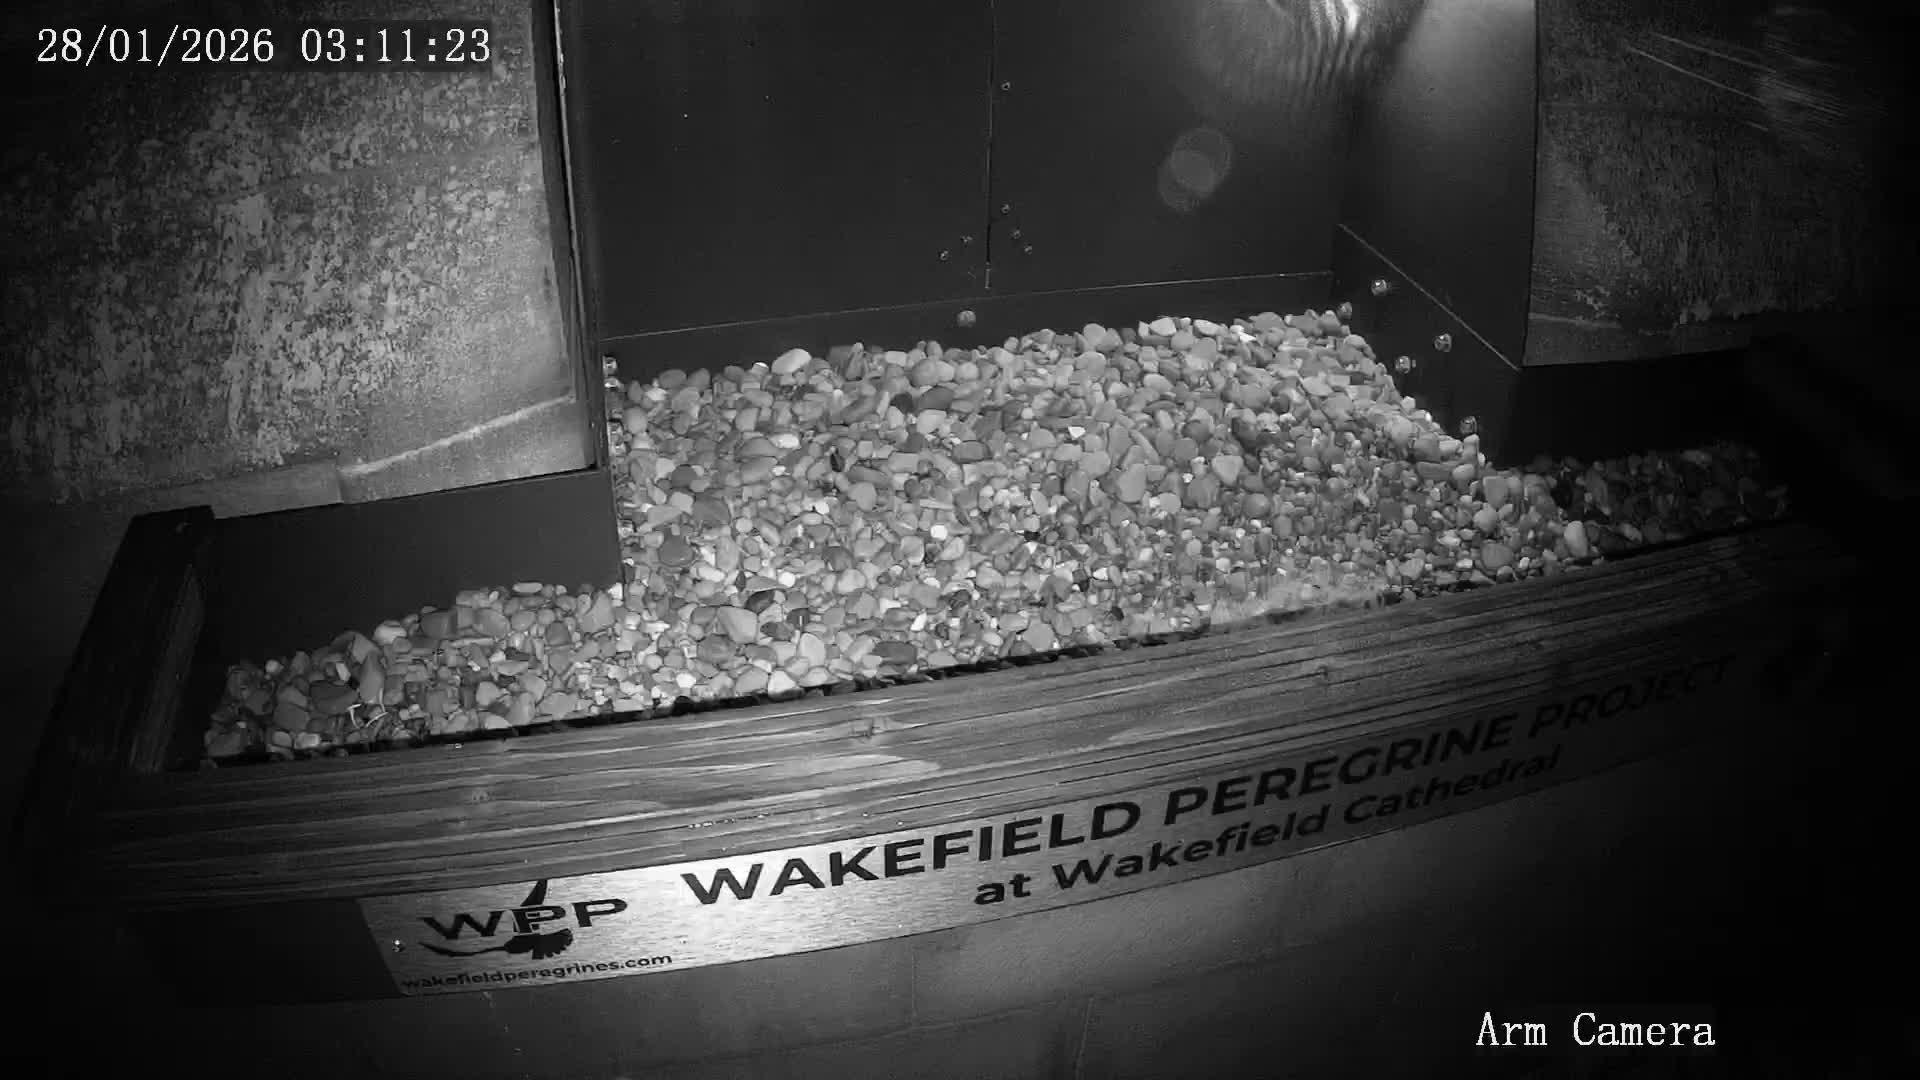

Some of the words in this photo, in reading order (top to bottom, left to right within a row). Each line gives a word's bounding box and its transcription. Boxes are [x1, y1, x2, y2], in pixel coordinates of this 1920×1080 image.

[681, 802, 1142, 905] WAKEFIELD
[1164, 712, 1518, 826] PEREGRINE
[1527, 654, 1736, 739] PROJECT
[974, 872, 1032, 906] at
[1051, 805, 1332, 890] Wakefield
[1343, 744, 1562, 825] Cathedral
[420, 898, 628, 940] WPP
[402, 953, 673, 990] wakefieldperegrines.com
